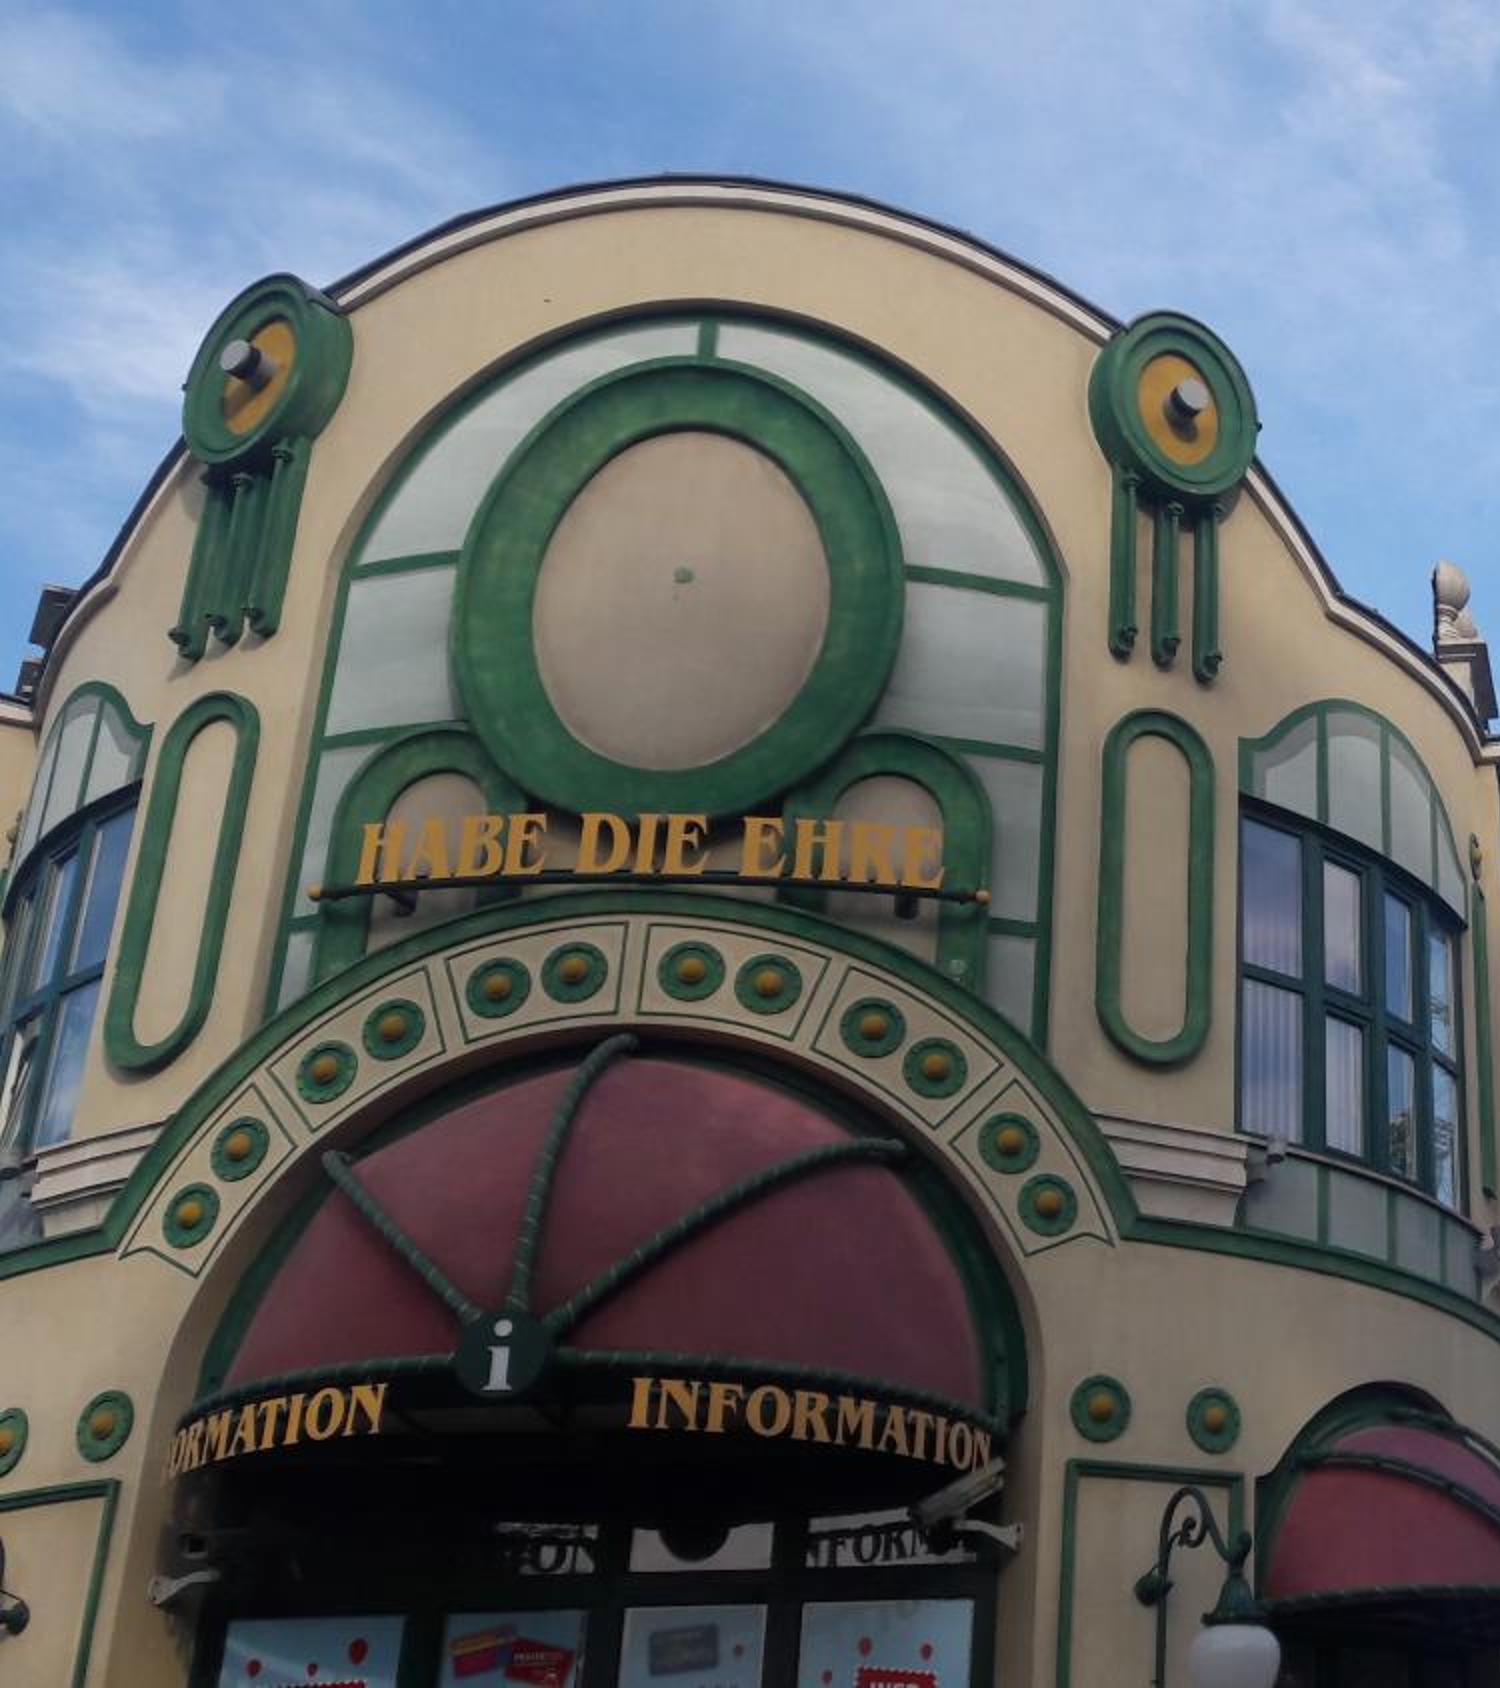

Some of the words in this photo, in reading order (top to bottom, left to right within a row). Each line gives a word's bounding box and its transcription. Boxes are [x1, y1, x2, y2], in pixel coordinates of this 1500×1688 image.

[356, 813, 547, 886] HABE
[574, 811, 706, 876] DIE
[737, 815, 945, 889] EHRE
[165, 1382, 388, 1478] ORMATION
[627, 1376, 993, 1473] INFORMATION
